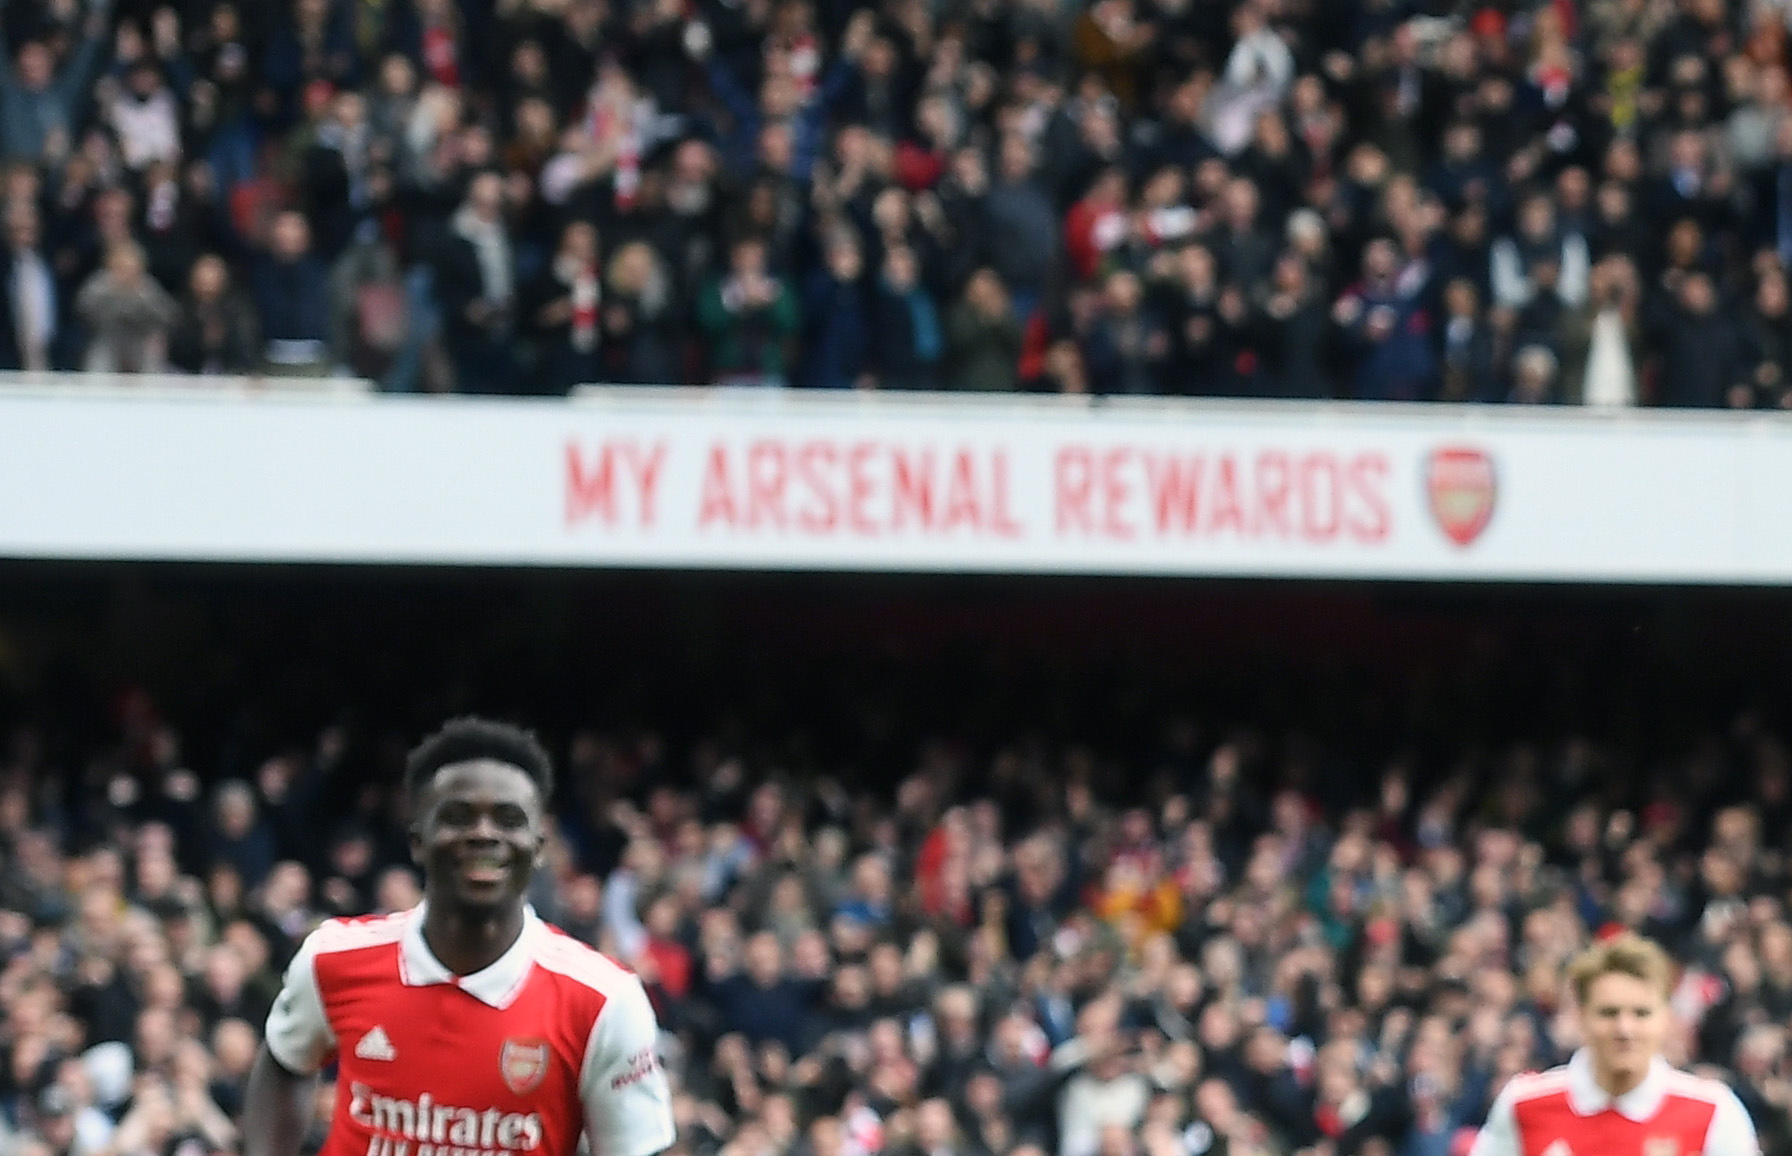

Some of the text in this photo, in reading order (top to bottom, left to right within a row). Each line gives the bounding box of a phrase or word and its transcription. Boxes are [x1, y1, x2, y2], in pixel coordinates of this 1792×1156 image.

[564, 438, 1393, 544] MY ARSENAL REWARDS
[349, 1080, 544, 1152] Emirates
